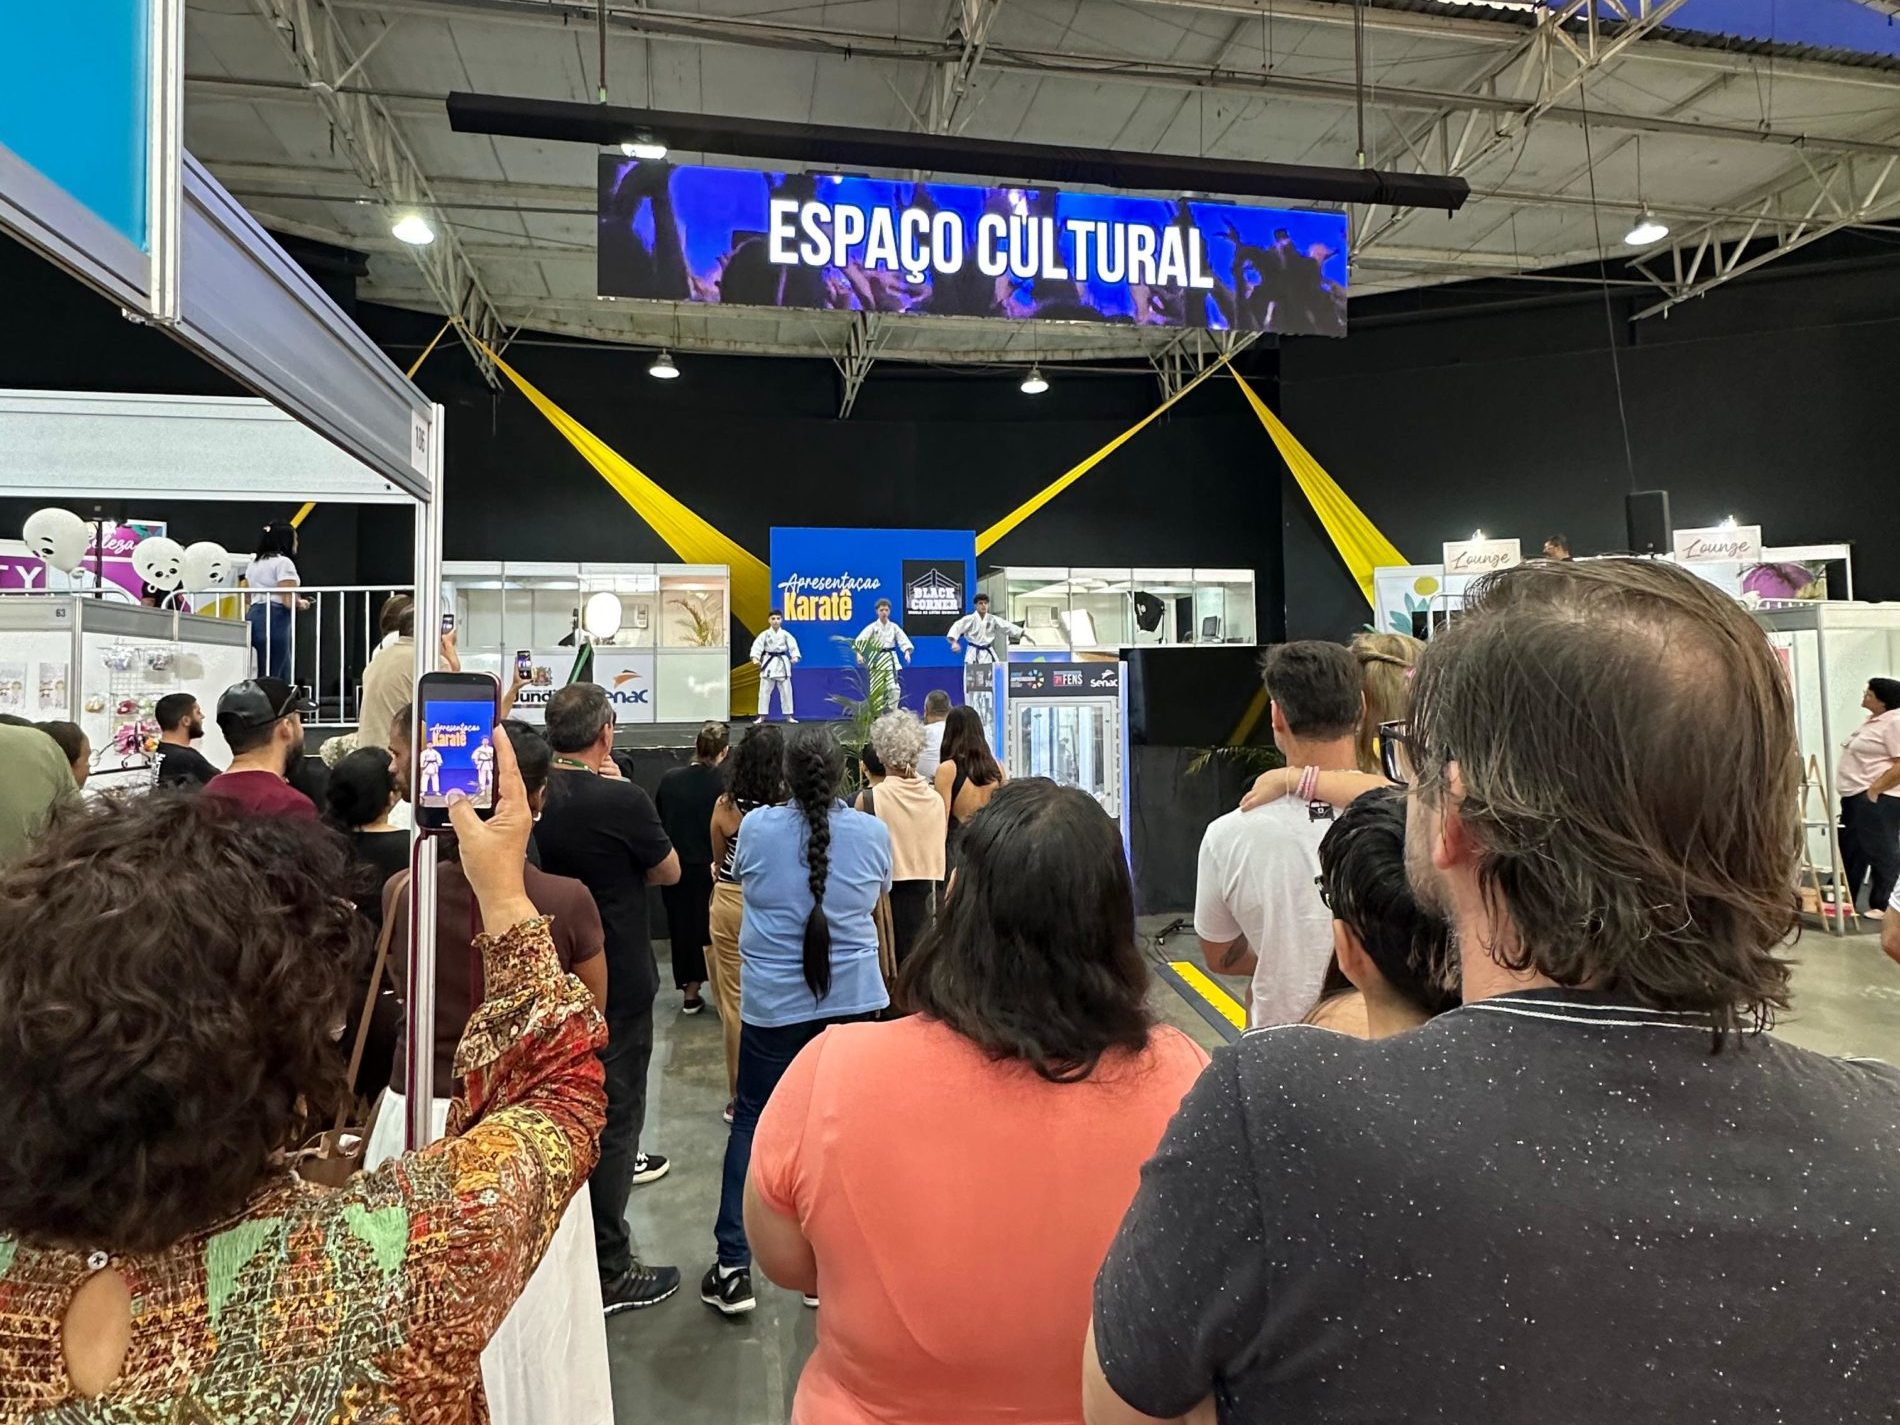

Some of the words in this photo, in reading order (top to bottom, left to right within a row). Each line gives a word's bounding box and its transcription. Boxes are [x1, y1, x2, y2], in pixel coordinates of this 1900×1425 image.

[769, 198, 964, 284] ESPAÇO
[978, 213, 1215, 289] CULTURAL
[1683, 539, 1751, 559] Lounge
[1451, 551, 1511, 569] Lounge
[913, 587, 955, 599] BLACK
[784, 588, 852, 621] Karatê
[911, 599, 958, 611] CORNER
[56, 608, 66, 617] 63
[1063, 674, 1083, 685] FENS
[604, 689, 649, 703] enac
